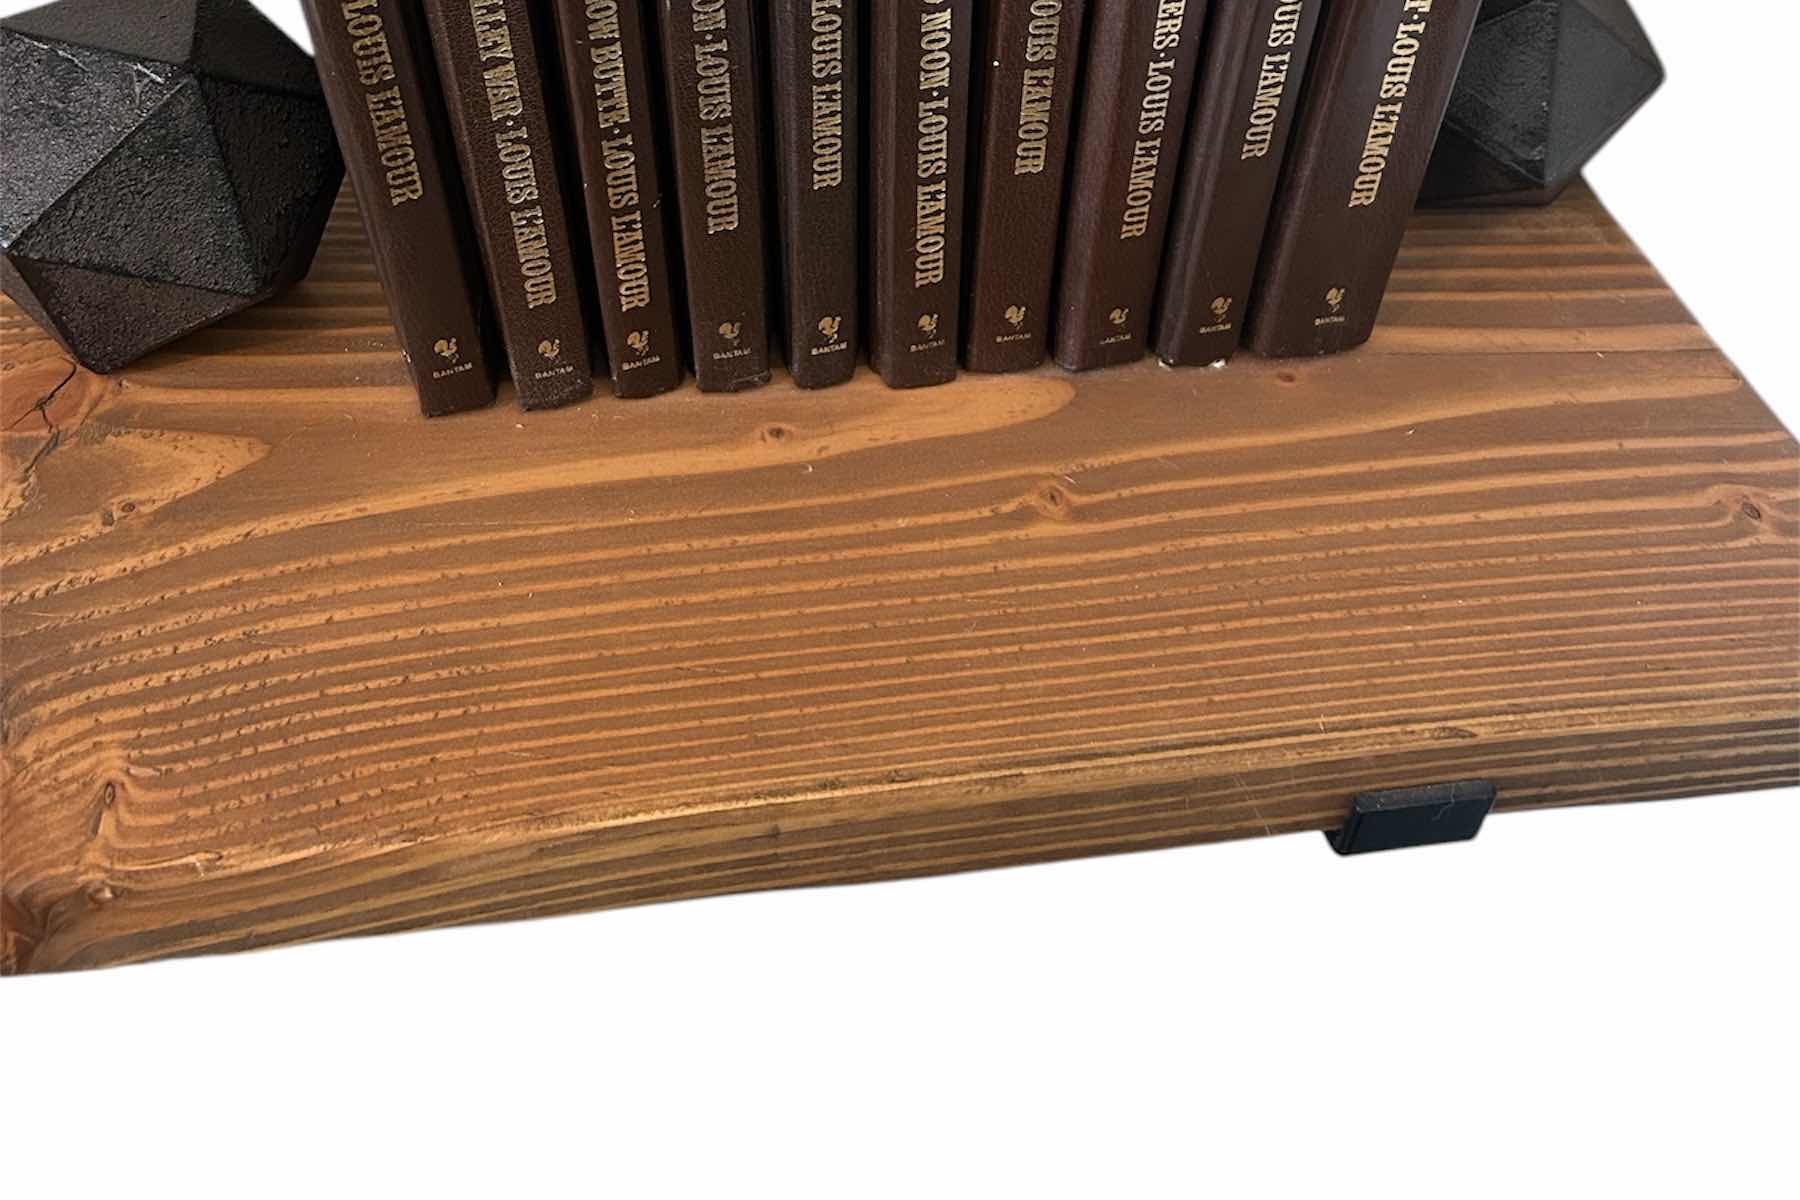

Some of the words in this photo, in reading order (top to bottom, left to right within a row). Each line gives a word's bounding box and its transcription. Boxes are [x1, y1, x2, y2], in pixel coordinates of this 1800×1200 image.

[590, 41, 629, 128] BUTTE
[695, 39, 732, 120] LOUIS
[919, 8, 951, 90] NOON
[1379, 21, 1426, 99] LOUIS
[483, 61, 522, 120] WAR
[1014, 66, 1055, 176] L'AMOUR
[1138, 57, 1175, 135] LOUIS
[1240, 51, 1291, 160] L'AMOUR
[366, 85, 423, 207] L'AMOUR
[496, 126, 539, 204] LOUIS
[601, 134, 639, 209] LOUIS
[812, 80, 842, 190] L'AMOUR
[917, 97, 949, 179] LOUIS
[1348, 101, 1402, 208] L'AMOUR
[701, 123, 738, 234] L'AMOUR
[1120, 137, 1162, 240] L'AMOUR
[510, 205, 557, 309] L'AMOUR
[610, 210, 650, 312] L'AMOUR
[915, 180, 946, 288] L'AMOUR
[432, 362, 472, 379] BANTAM
[535, 365, 574, 380] BANTAM
[621, 355, 660, 371] BANTAM
[811, 341, 848, 356] BANTAM
[910, 339, 945, 352] BANTAM
[995, 333, 1031, 343] BANTAM
